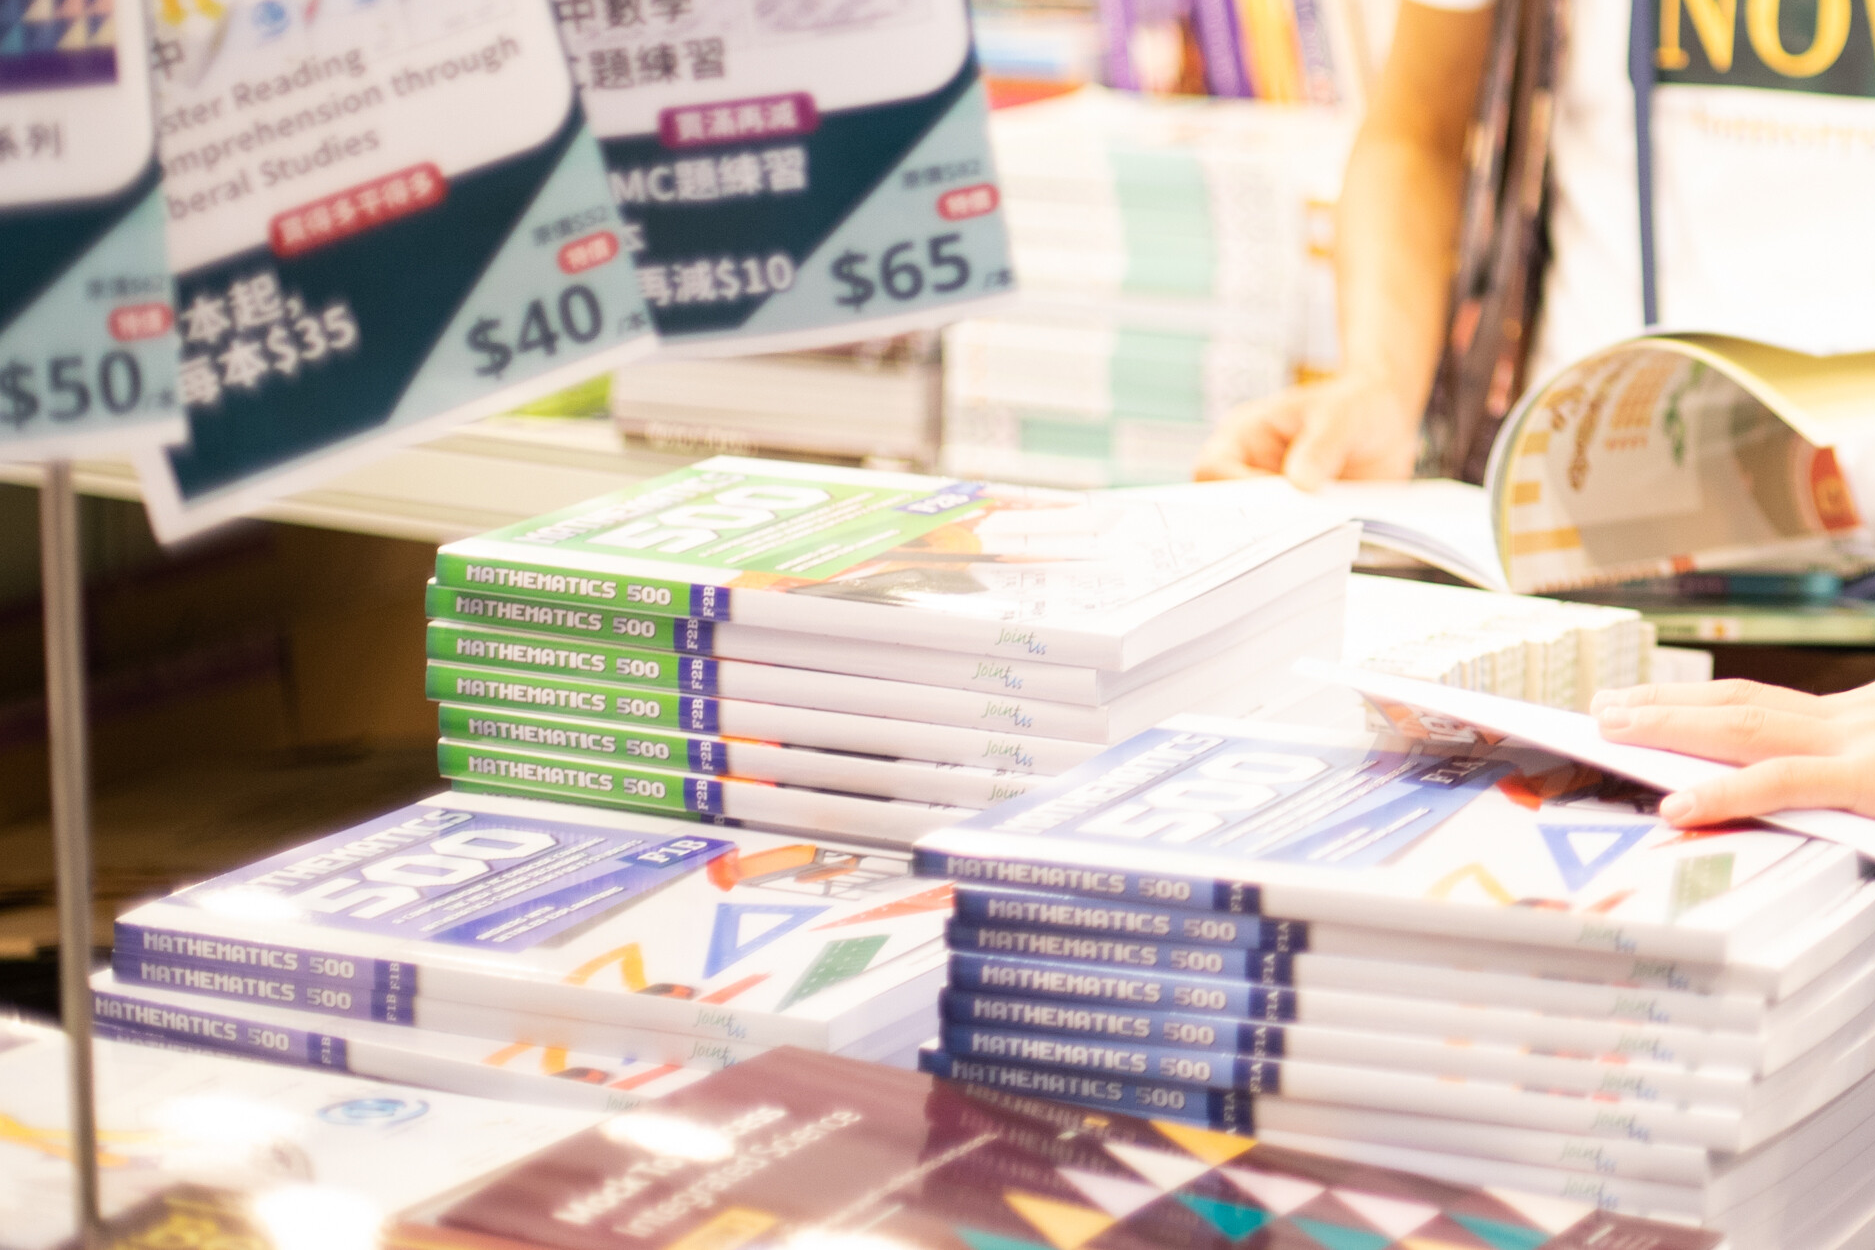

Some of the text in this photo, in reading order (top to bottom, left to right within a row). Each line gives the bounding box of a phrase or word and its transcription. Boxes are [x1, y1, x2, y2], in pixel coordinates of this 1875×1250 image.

[231, 47, 368, 109] Reading
[391, 33, 521, 97] through
[569, 36, 726, 91] 題練習
[258, 127, 382, 188] Studies
[829, 232, 972, 312] $65
[466, 283, 604, 379] $40
[0, 349, 143, 432] $50
[586, 483, 833, 554] 500
[466, 564, 673, 606] MATHEMATICS 500
[702, 585, 716, 618] F2B
[456, 596, 657, 638] MATHEMATICS 500
[456, 637, 661, 679] MATHEMATICS 500
[691, 659, 704, 690] F2B
[456, 677, 661, 719] MATHEMATICS 500
[691, 697, 704, 730] F2B
[468, 718, 670, 761] MATHEMATICS 500
[700, 740, 713, 772] F2B
[468, 756, 667, 799] MATHEMATICS 500
[696, 780, 709, 810] F2B
[1075, 751, 1335, 844] 500
[245, 809, 476, 892] THEMATICS
[300, 829, 560, 920] 500
[636, 836, 709, 865] F1B
[947, 855, 1192, 901] MATHEMATICS 500
[988, 897, 1237, 942] MATHEMATICS 500
[143, 931, 355, 979] MATHEMATICS 500
[978, 927, 1224, 972] MATHEMATICS 500
[141, 962, 352, 1011] MATHEMATICS 500
[981, 964, 1227, 1010] MATHEMATICS 500
[95, 996, 238, 1041] MATHEMATICS
[247, 1027, 290, 1052] 500
[974, 998, 1216, 1046] MATHEMATICS 500
[972, 1032, 1212, 1081] MATHEMATICS 500
[952, 1059, 1186, 1110] MATHEMATICS 500
